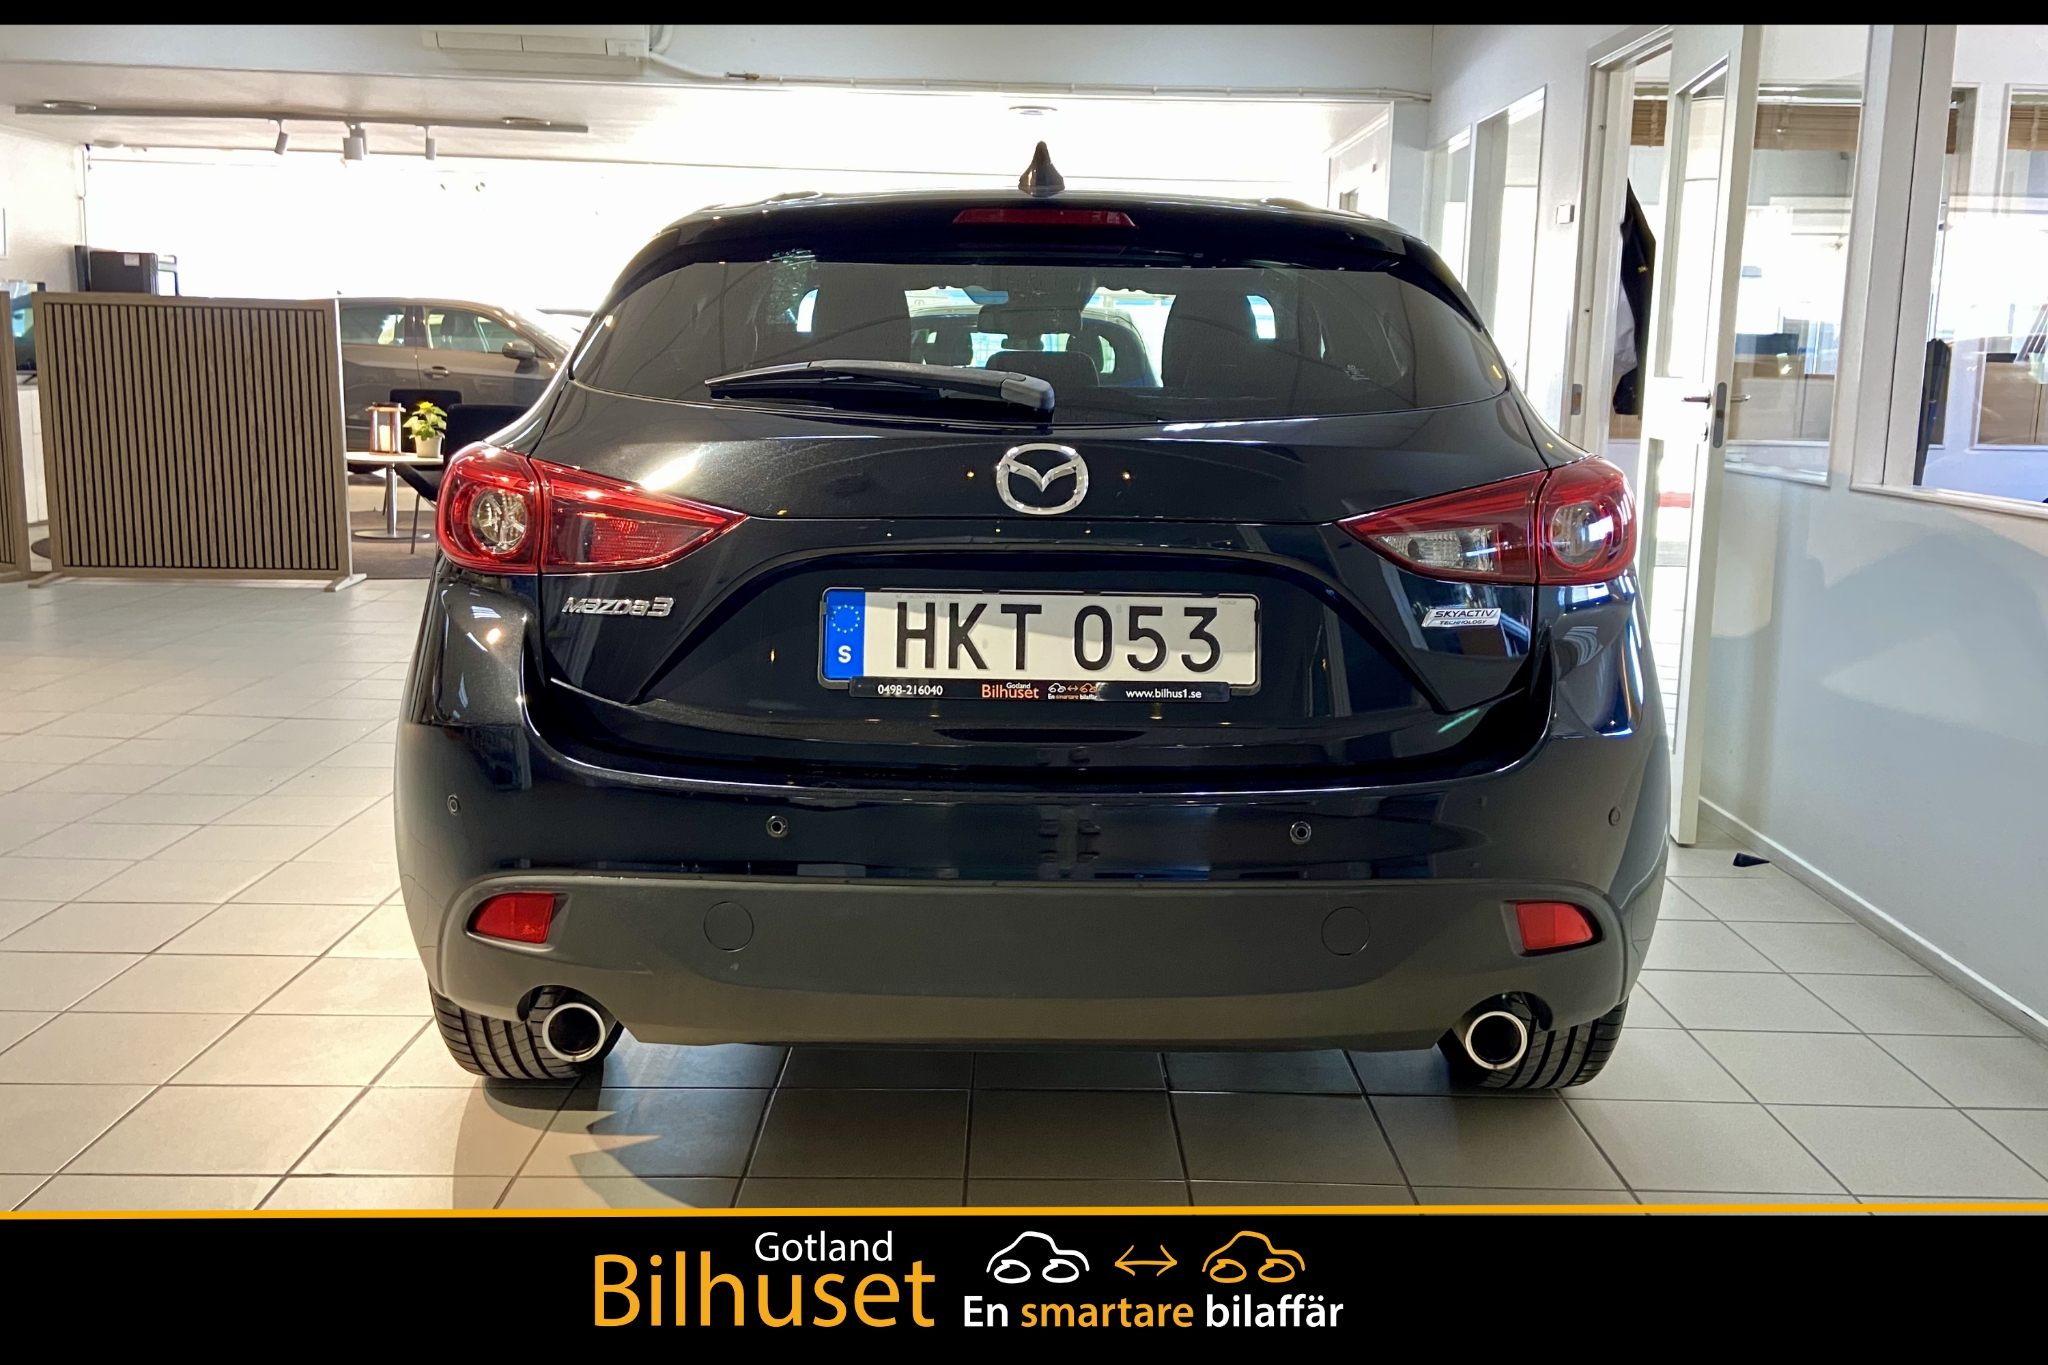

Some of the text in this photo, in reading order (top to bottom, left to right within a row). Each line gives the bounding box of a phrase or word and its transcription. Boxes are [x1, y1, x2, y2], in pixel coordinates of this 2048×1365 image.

[1434, 609, 1495, 618] SKYACTIV
[897, 602, 1220, 673] HKT 053
[837, 646, 852, 664] S
[877, 684, 944, 696] 0498-216040
[981, 684, 1040, 699] Bilhuset
[1006, 682, 1031, 690] Gotland
[1125, 688, 1202, 699] www.bilhus1.se
